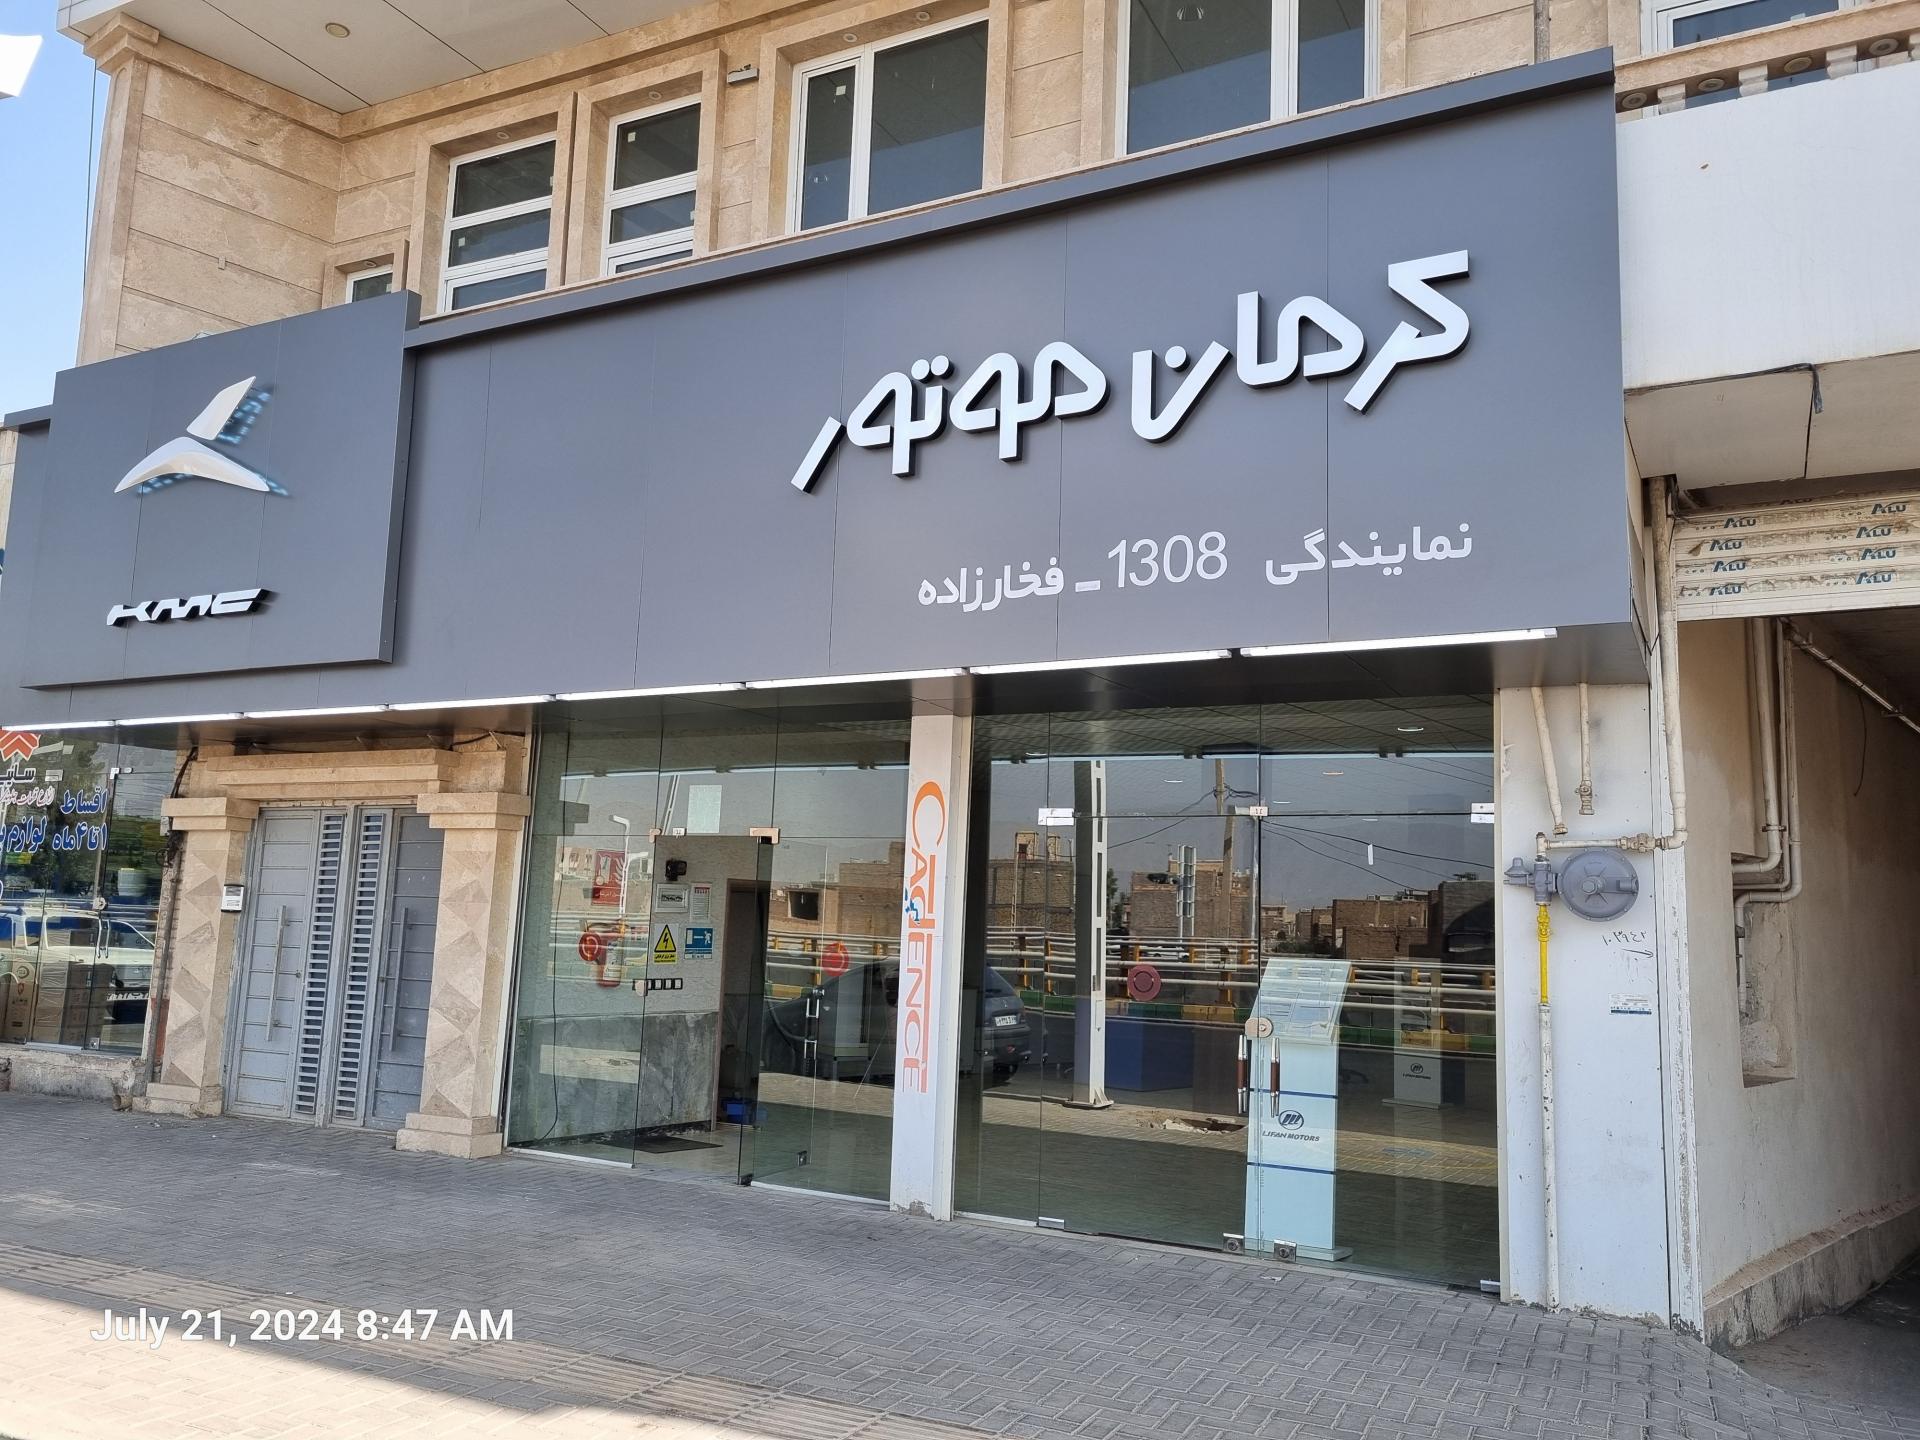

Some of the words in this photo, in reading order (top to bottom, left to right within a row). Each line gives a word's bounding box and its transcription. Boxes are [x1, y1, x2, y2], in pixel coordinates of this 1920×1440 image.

[1131, 249, 1471, 443] کرمان
[790, 341, 1109, 492] موتور
[1871, 501, 1909, 515] ALU
[1723, 516, 1757, 529] ALU
[1855, 525, 1892, 539] ALU
[1709, 538, 1744, 552] ALU
[1107, 531, 1228, 588] 1308
[1265, 522, 1473, 585] نمایندگی
[1860, 547, 1897, 561] ALU
[1712, 559, 1747, 573] ALU
[917, 556, 1065, 613] فخارزاده
[1855, 571, 1894, 585] ALU
[1708, 583, 1744, 596] ALU
[106, 588, 264, 627] KMC
[60, 785, 108, 815] اقساط
[6, 815, 48, 854] لوازم
[1262, 1130, 1287, 1139] LIFAN
[1287, 1133, 1320, 1142] MOTORS
